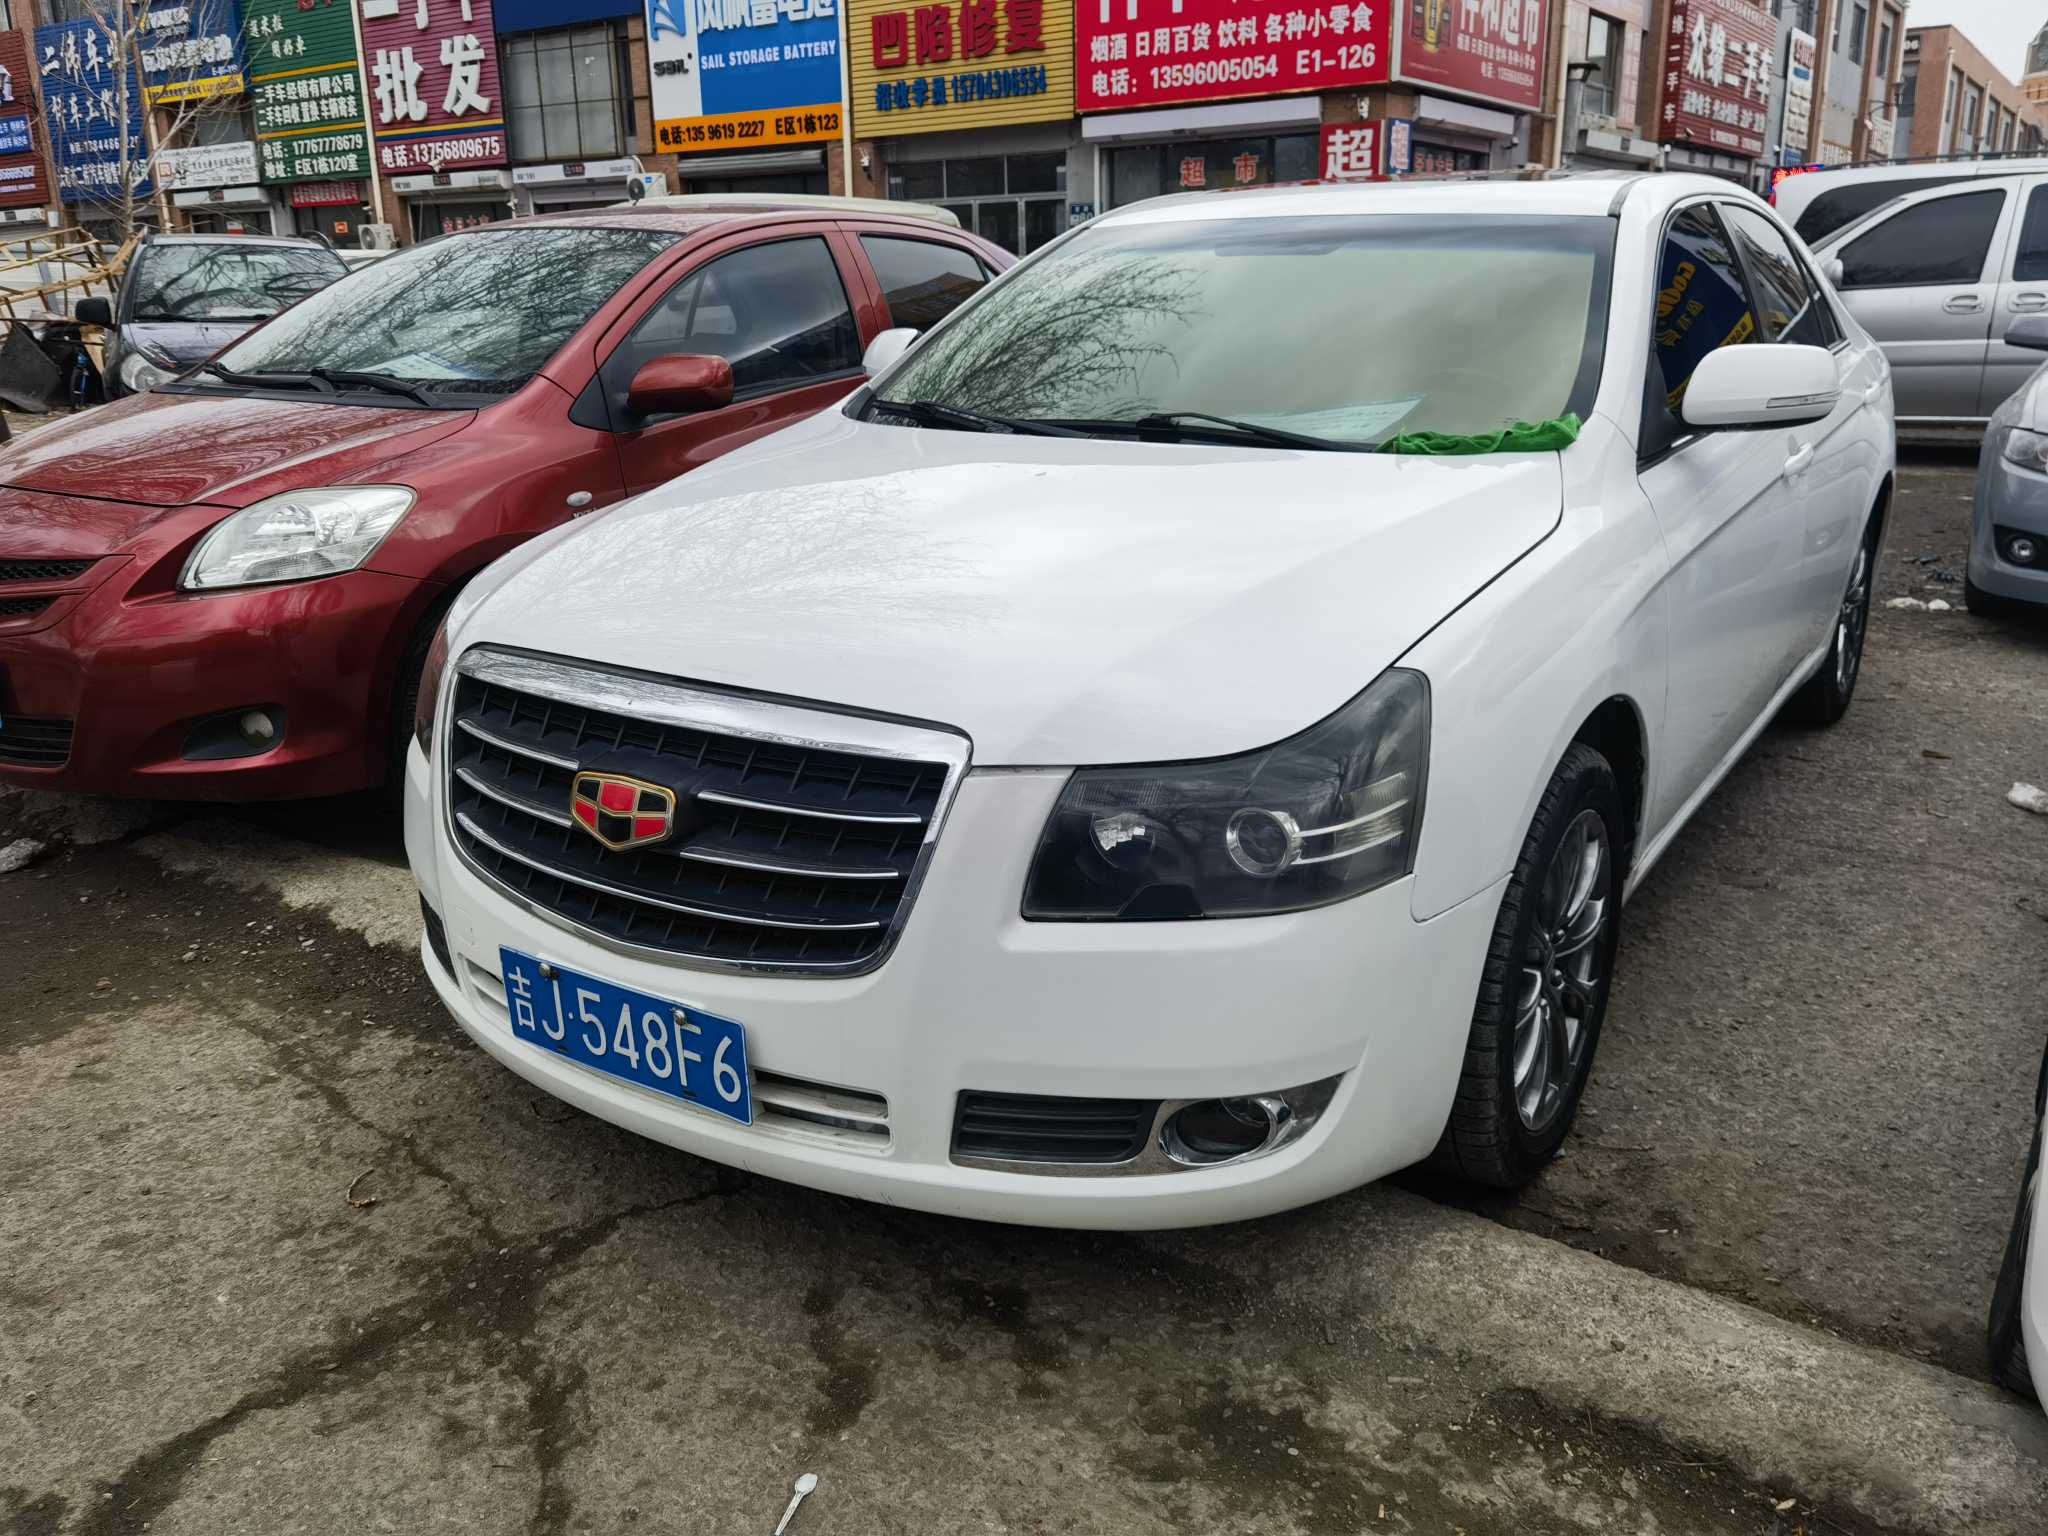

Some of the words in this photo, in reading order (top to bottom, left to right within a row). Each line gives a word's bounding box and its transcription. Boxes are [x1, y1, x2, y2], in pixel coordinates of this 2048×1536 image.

[700, 54, 726, 71] SAIL
[729, 46, 780, 67] STORAGE
[784, 39, 837, 60] BATTERY
[871, 0, 1046, 70] 凹陷修复
[1089, 32, 1129, 64] 烟酒
[1135, 22, 1213, 57] 日用百货
[1216, 16, 1259, 49] 饮料
[1263, 1, 1375, 44] 各种小零食
[371, 34, 491, 125] 批发
[1091, 67, 1139, 98] 电话：
[1149, 53, 1279, 91] 13596005054
[1295, 42, 1377, 76] E1-126
[1686, 12, 1774, 106] 众缘二手车
[254, 73, 356, 104] 二手车经销有限公司
[292, 133, 364, 156] 17767778679
[381, 135, 500, 169] 电话:13756809675
[707, 124, 736, 141] 9619
[738, 119, 766, 138] 2227
[775, 113, 840, 136] E区1栋123
[1324, 127, 1375, 179] 超
[294, 152, 360, 176] E区1栋120室
[507, 965, 742, 1104] 吉J·548F6
